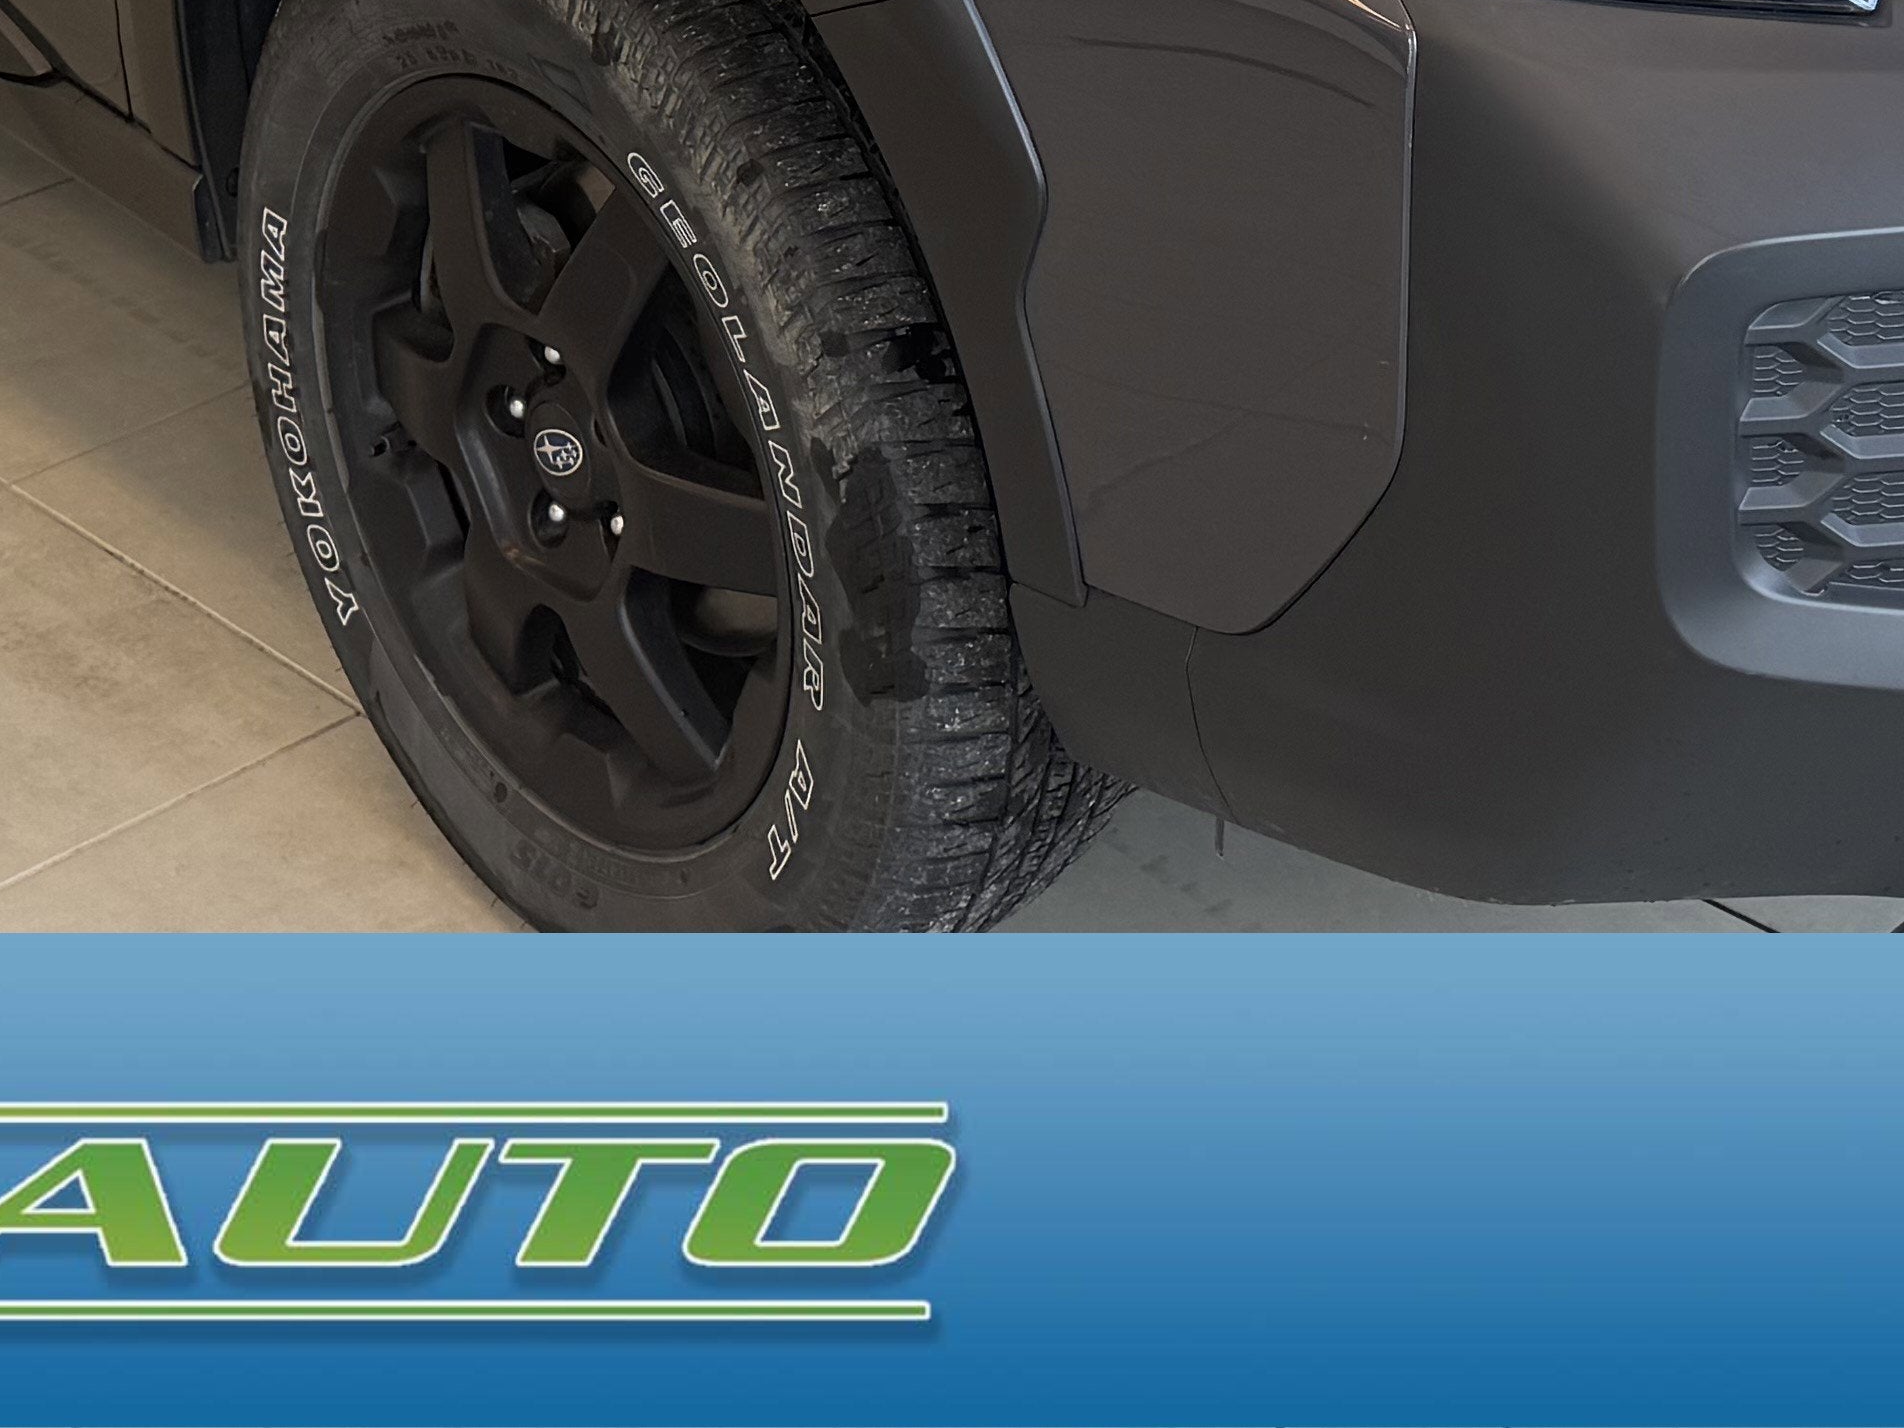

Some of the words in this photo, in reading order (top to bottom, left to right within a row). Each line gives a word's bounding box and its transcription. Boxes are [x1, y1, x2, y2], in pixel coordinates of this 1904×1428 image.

[261, 207, 359, 626] YOKOHAMA
[626, 152, 824, 711] GEOLANDAR
[767, 739, 814, 880] A/T
